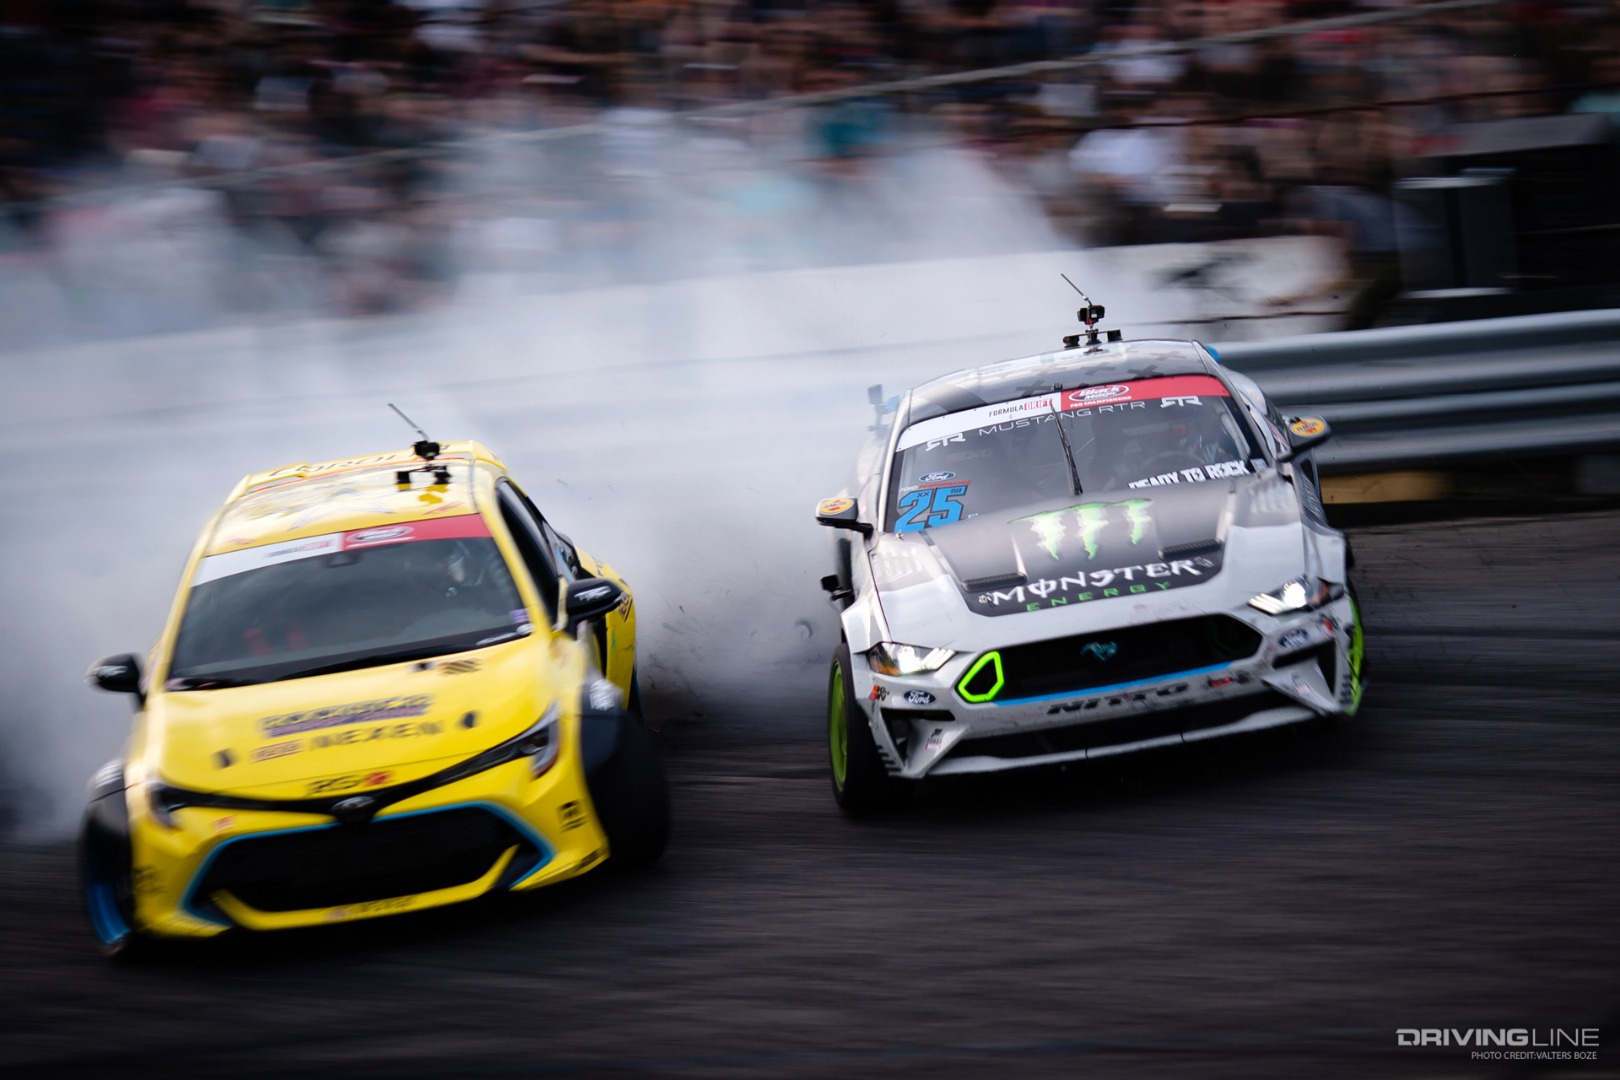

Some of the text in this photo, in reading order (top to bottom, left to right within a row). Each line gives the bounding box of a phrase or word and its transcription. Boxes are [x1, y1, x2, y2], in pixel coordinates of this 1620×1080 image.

[978, 401, 1147, 437] MUSTANG RTR
[1180, 467, 1206, 483] TO
[1203, 459, 1251, 480] ROCK
[894, 485, 968, 534] 25
[991, 558, 1203, 606] MONSTER
[1026, 581, 1171, 613] ENERGY
